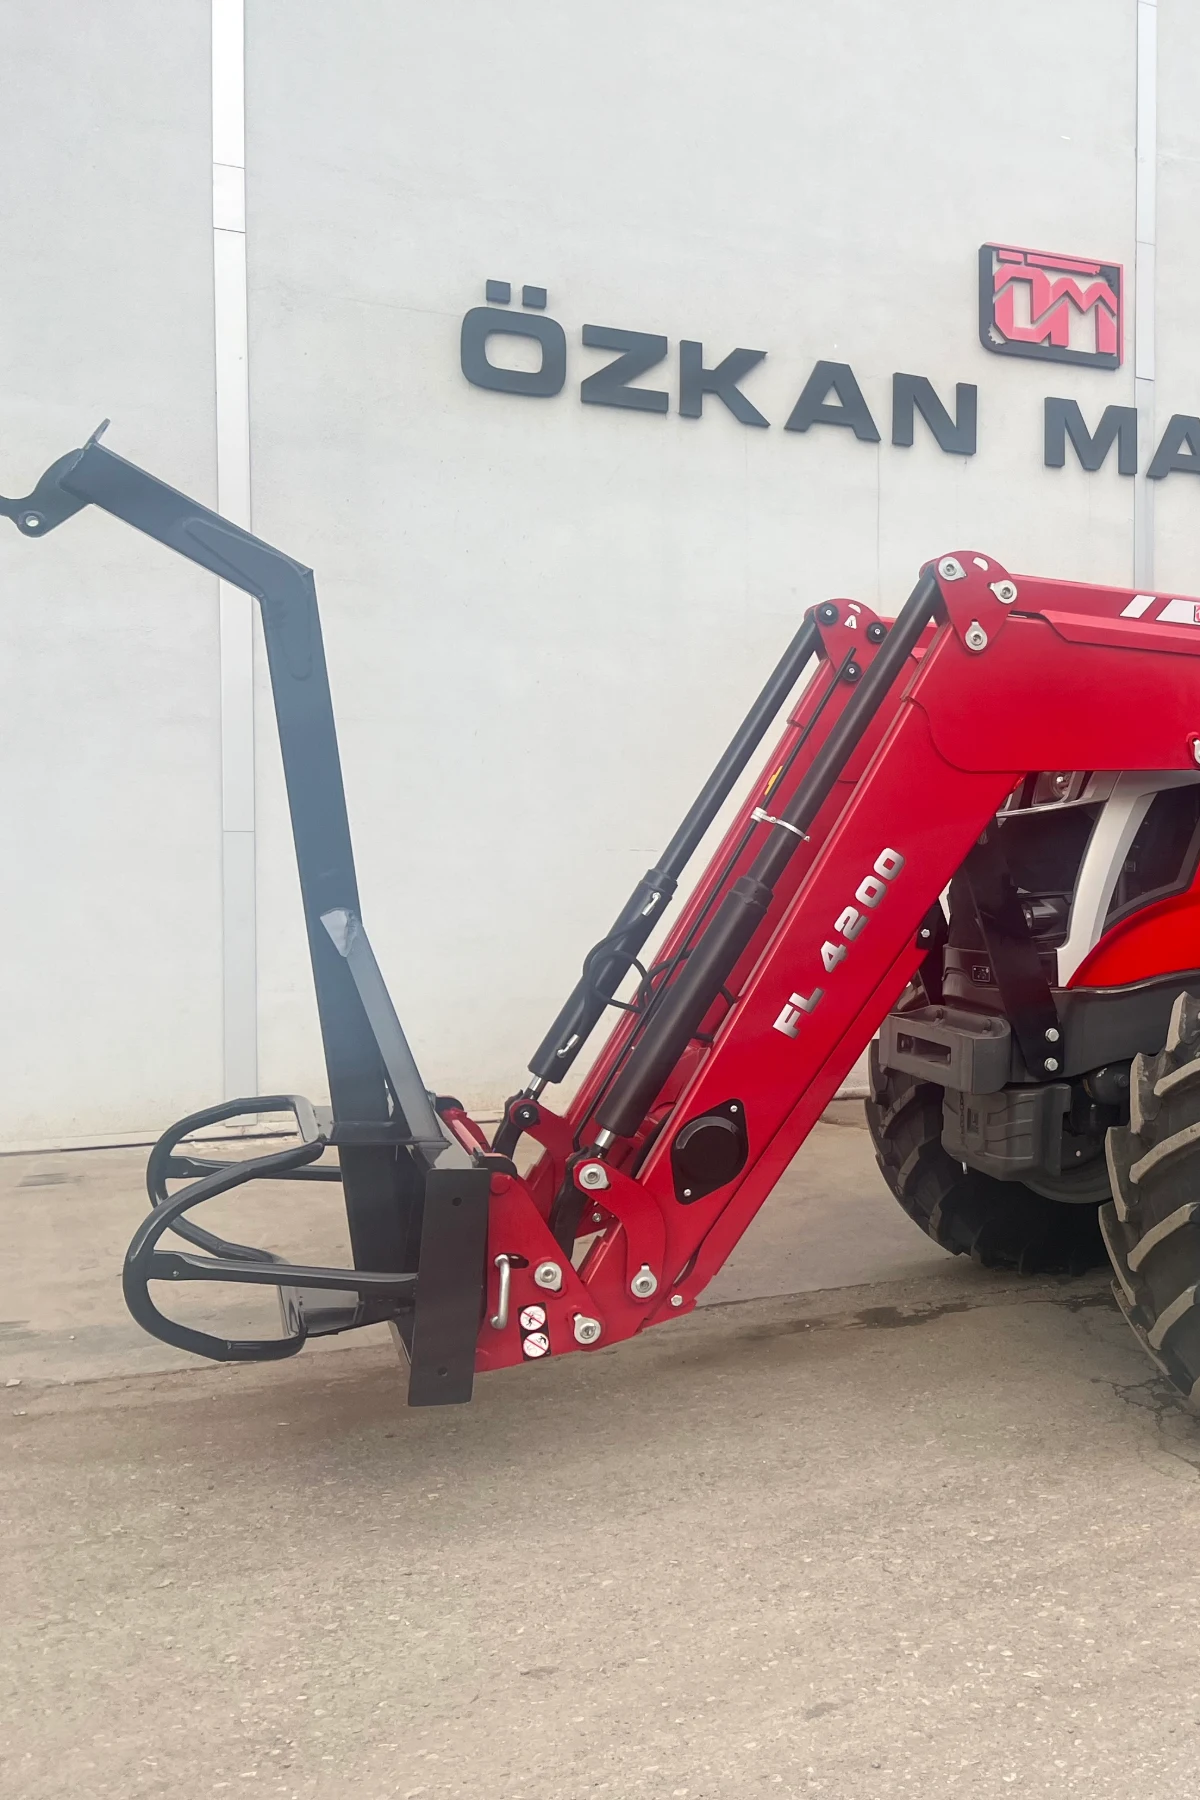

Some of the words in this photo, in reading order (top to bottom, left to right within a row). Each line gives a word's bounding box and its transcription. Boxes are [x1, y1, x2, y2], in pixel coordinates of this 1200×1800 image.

[461, 279, 977, 456] ÖZKAN
[772, 986, 825, 1040] FL
[820, 847, 906, 974] 4200
